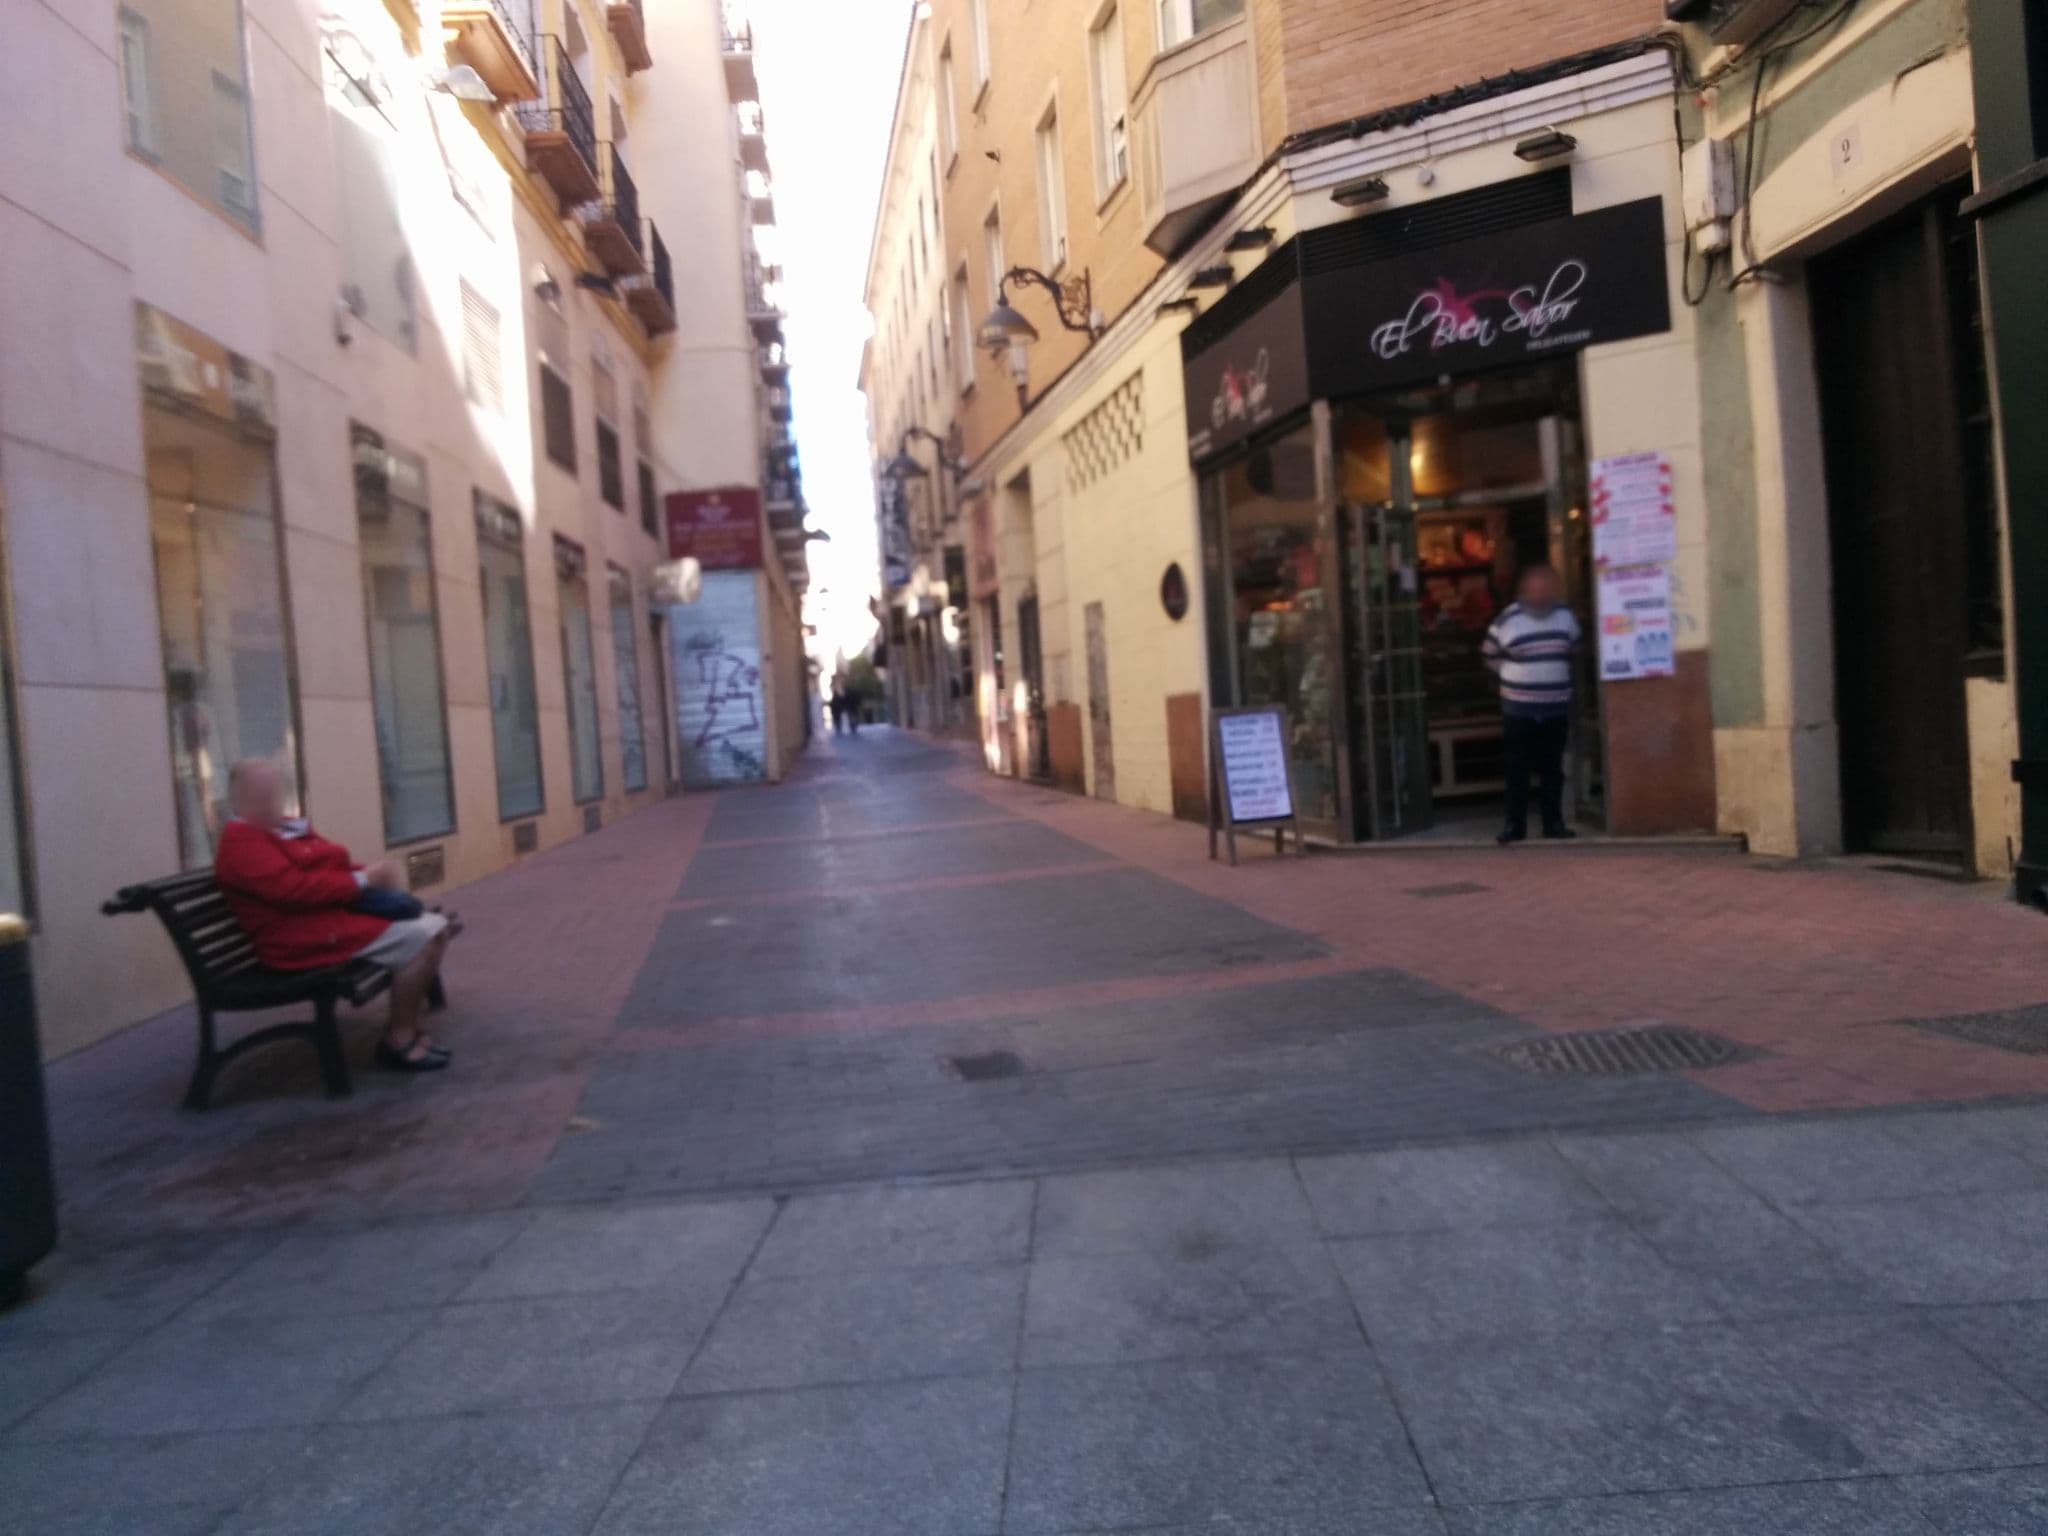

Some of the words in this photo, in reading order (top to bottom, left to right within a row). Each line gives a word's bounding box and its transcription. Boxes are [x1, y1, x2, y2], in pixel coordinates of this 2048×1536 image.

[1841, 138, 1851, 164] 2
[1370, 292, 1442, 359] El
[1423, 312, 1497, 347] Buen
[1502, 261, 1585, 338] Sabor
